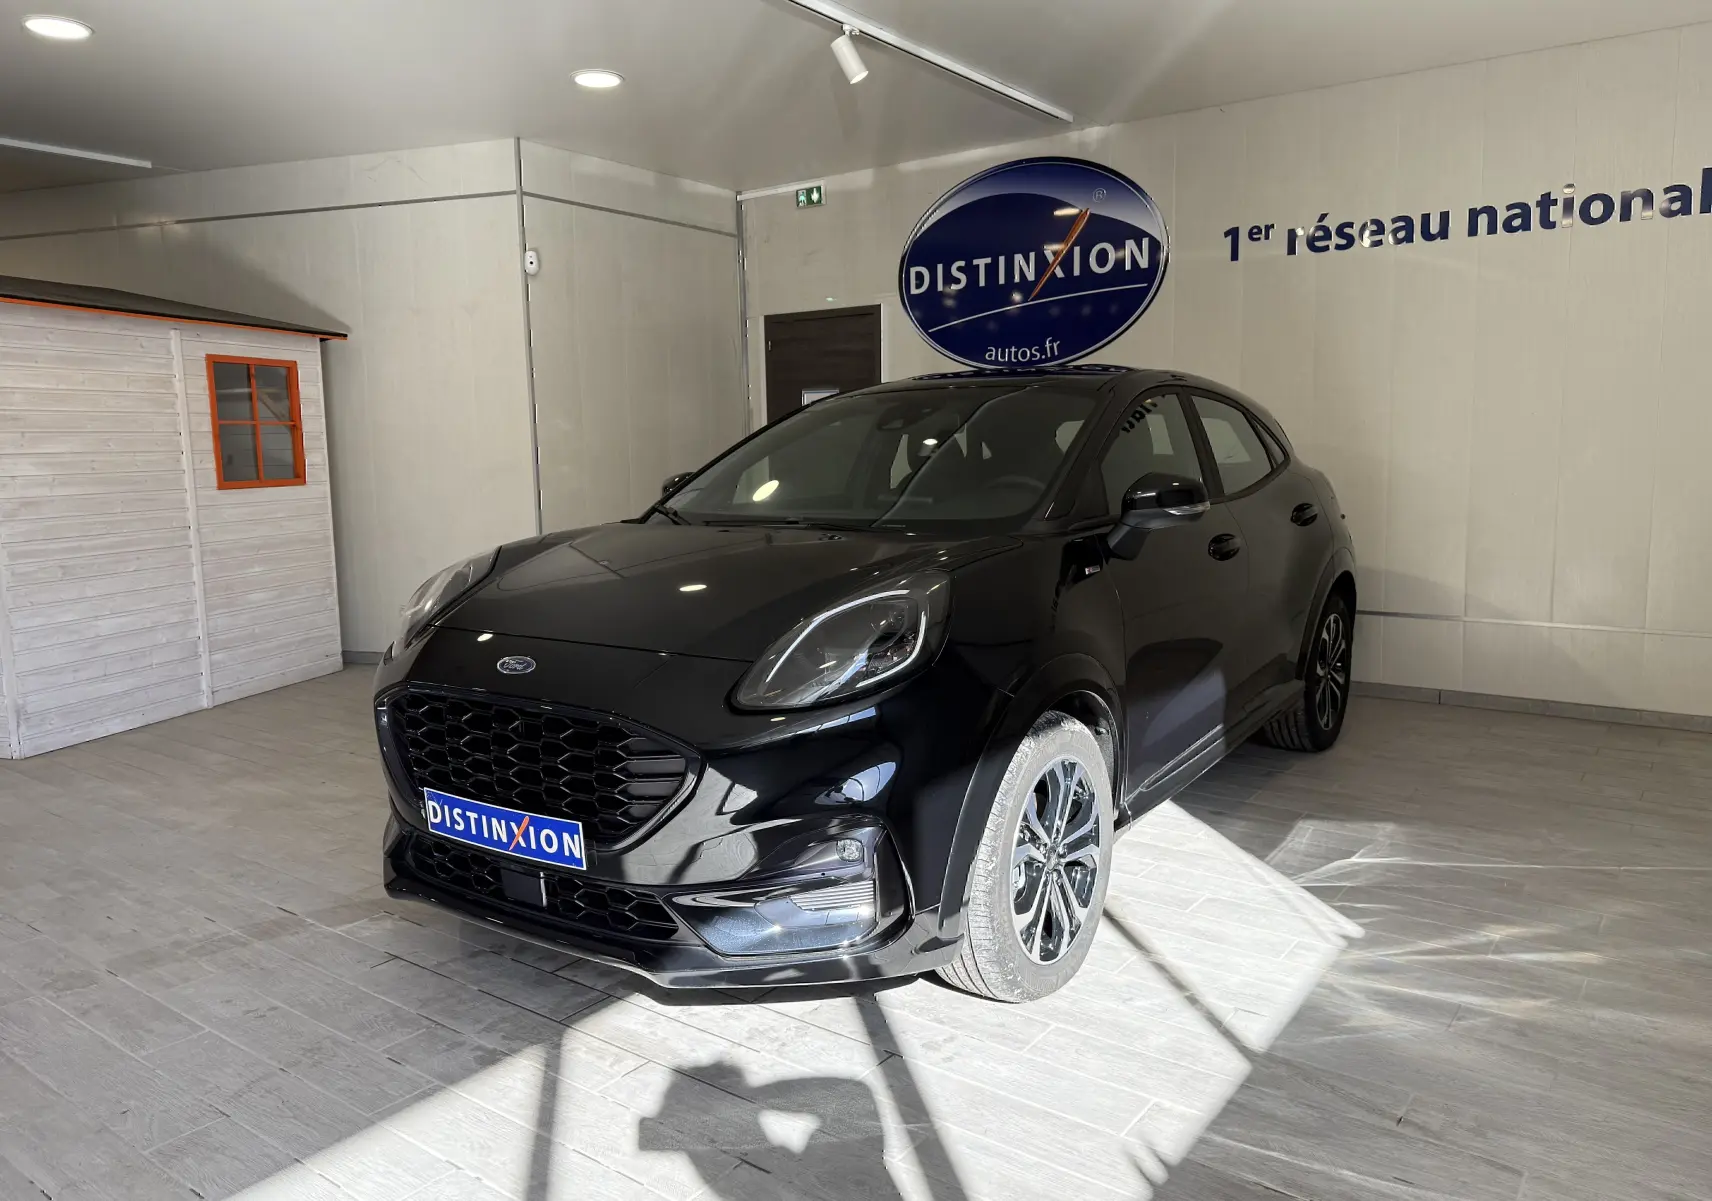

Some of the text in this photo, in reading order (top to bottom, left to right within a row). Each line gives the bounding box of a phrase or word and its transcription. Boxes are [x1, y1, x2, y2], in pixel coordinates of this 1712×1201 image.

[1223, 167, 1712, 262] 1er réseau national
[909, 208, 1149, 301] DISTINXION
[985, 337, 1061, 362] autos.fr
[428, 800, 581, 859] DISTINXION
